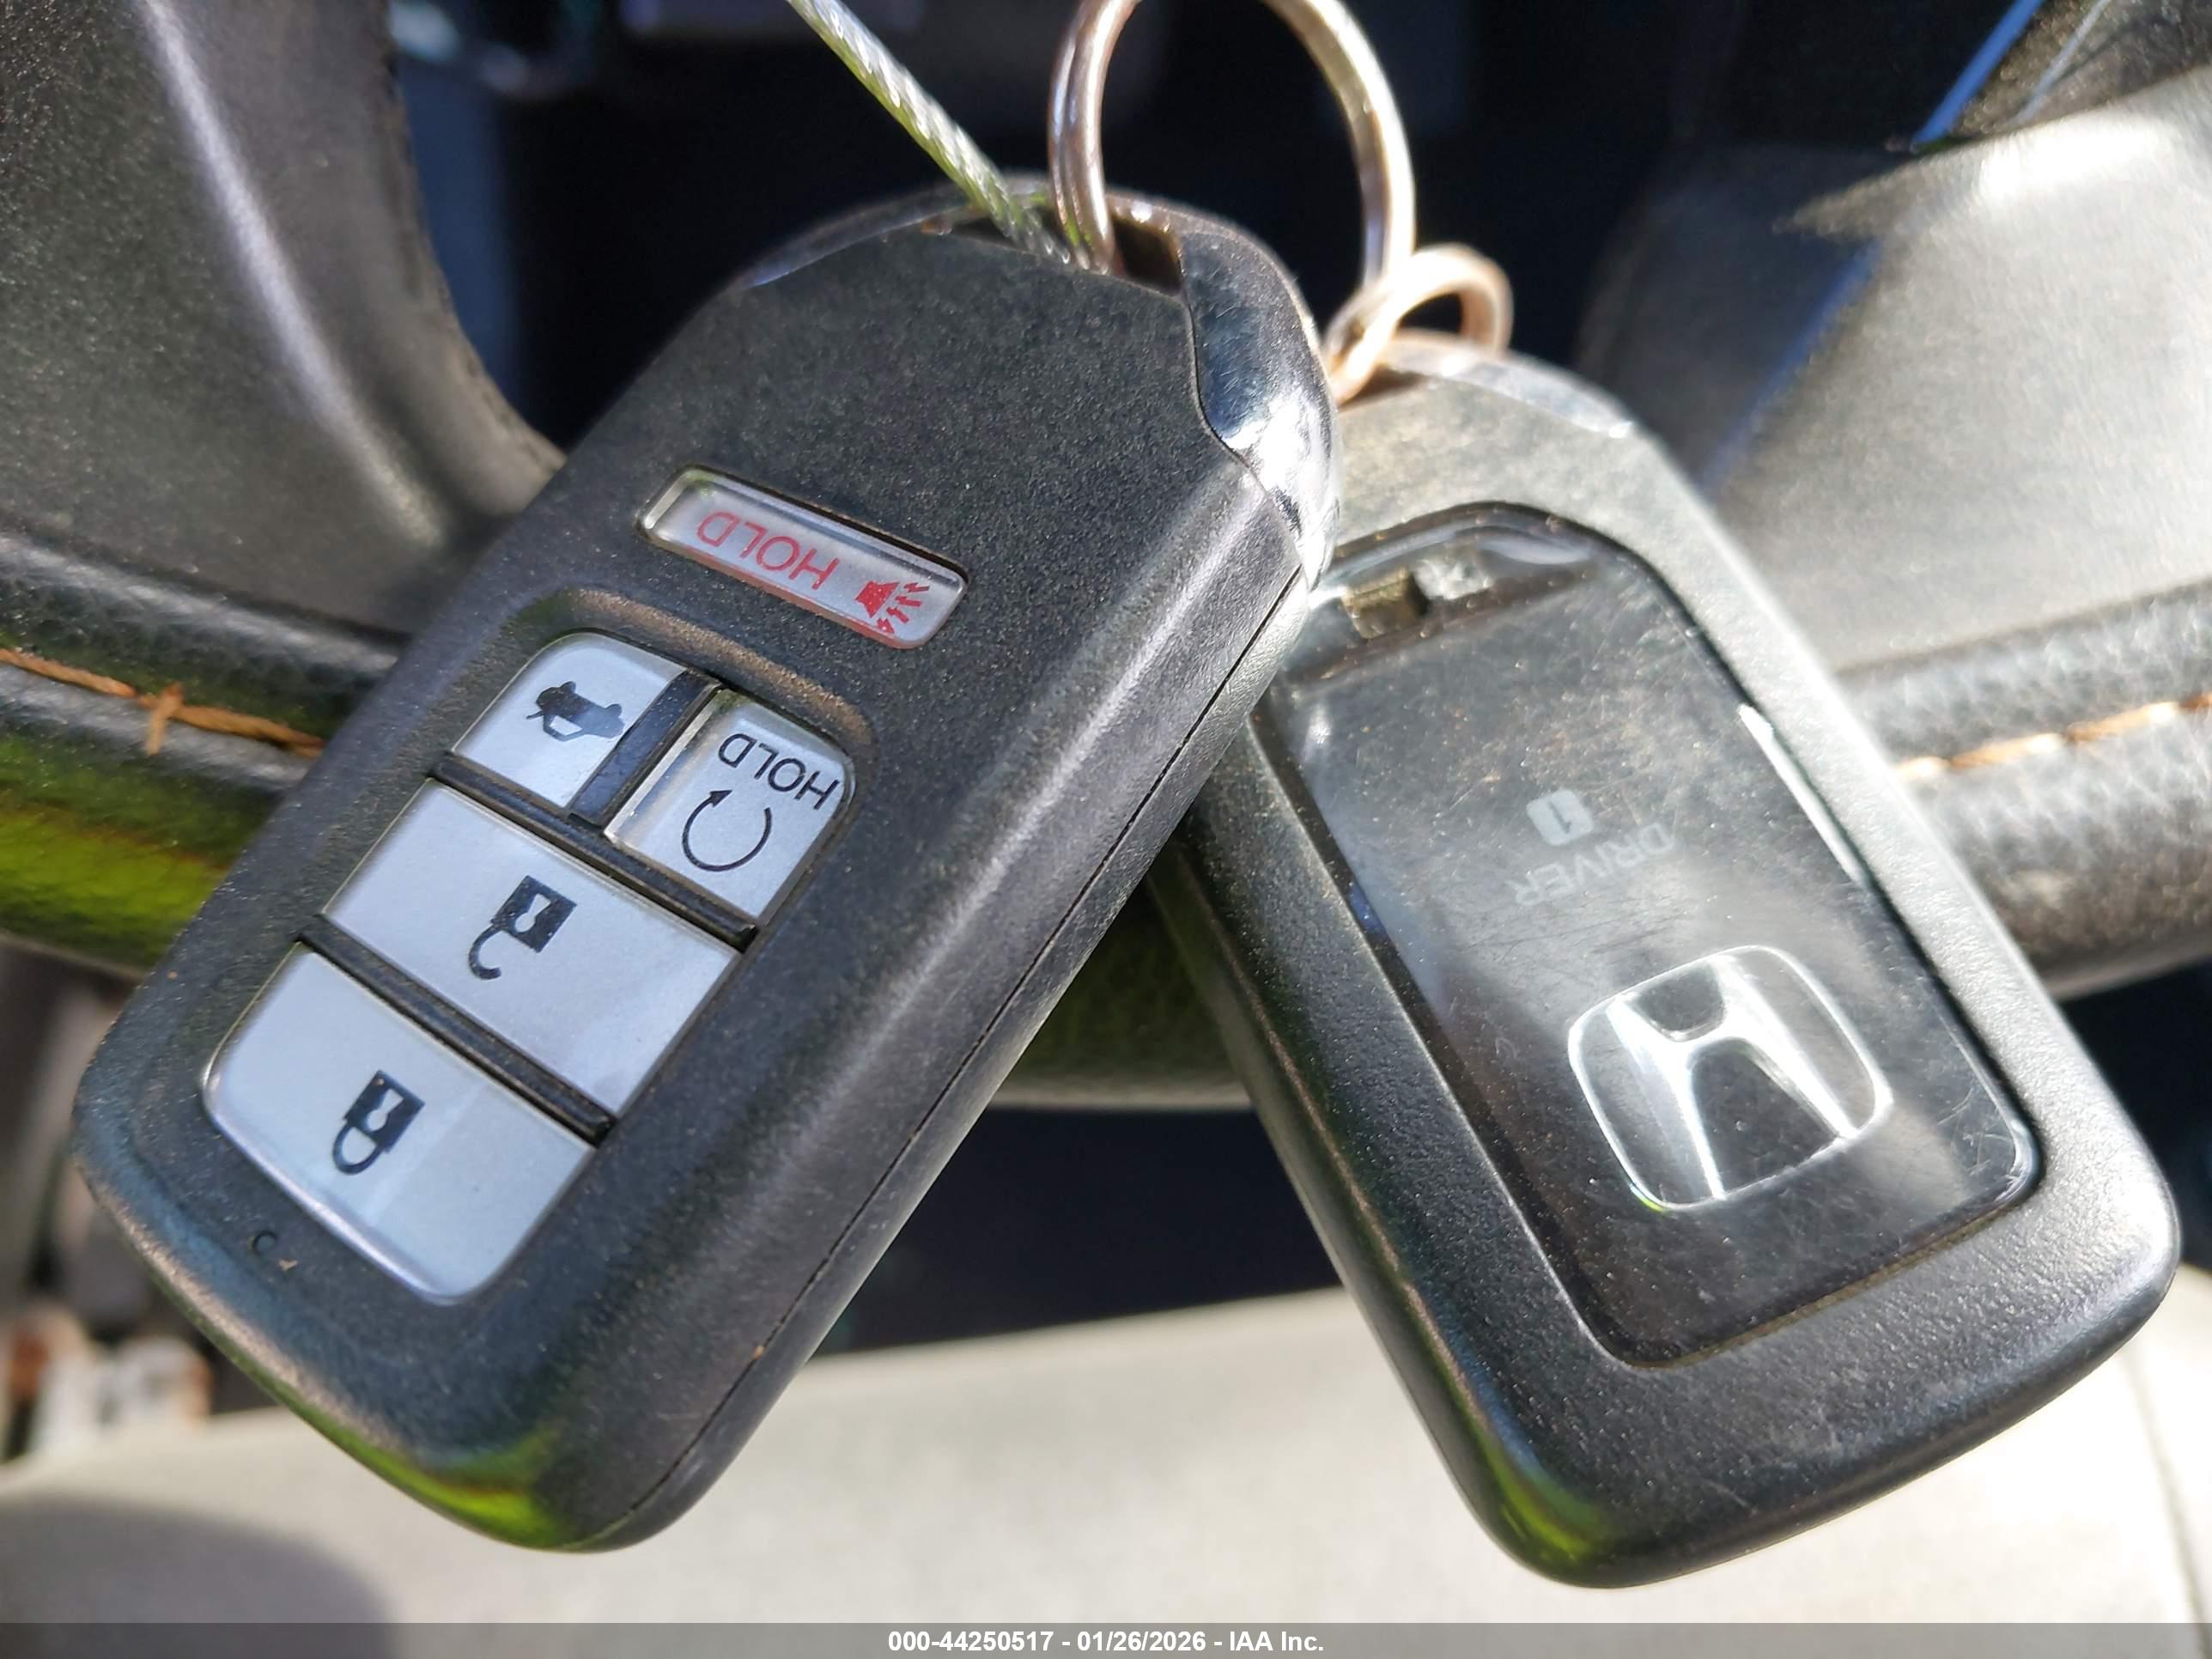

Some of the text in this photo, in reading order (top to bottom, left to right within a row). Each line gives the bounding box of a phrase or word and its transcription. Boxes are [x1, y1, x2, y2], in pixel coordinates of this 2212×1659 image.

[695, 511, 839, 591] HOLD
[718, 733, 840, 810] HOLD
[1504, 822, 1675, 907] DRIVER
